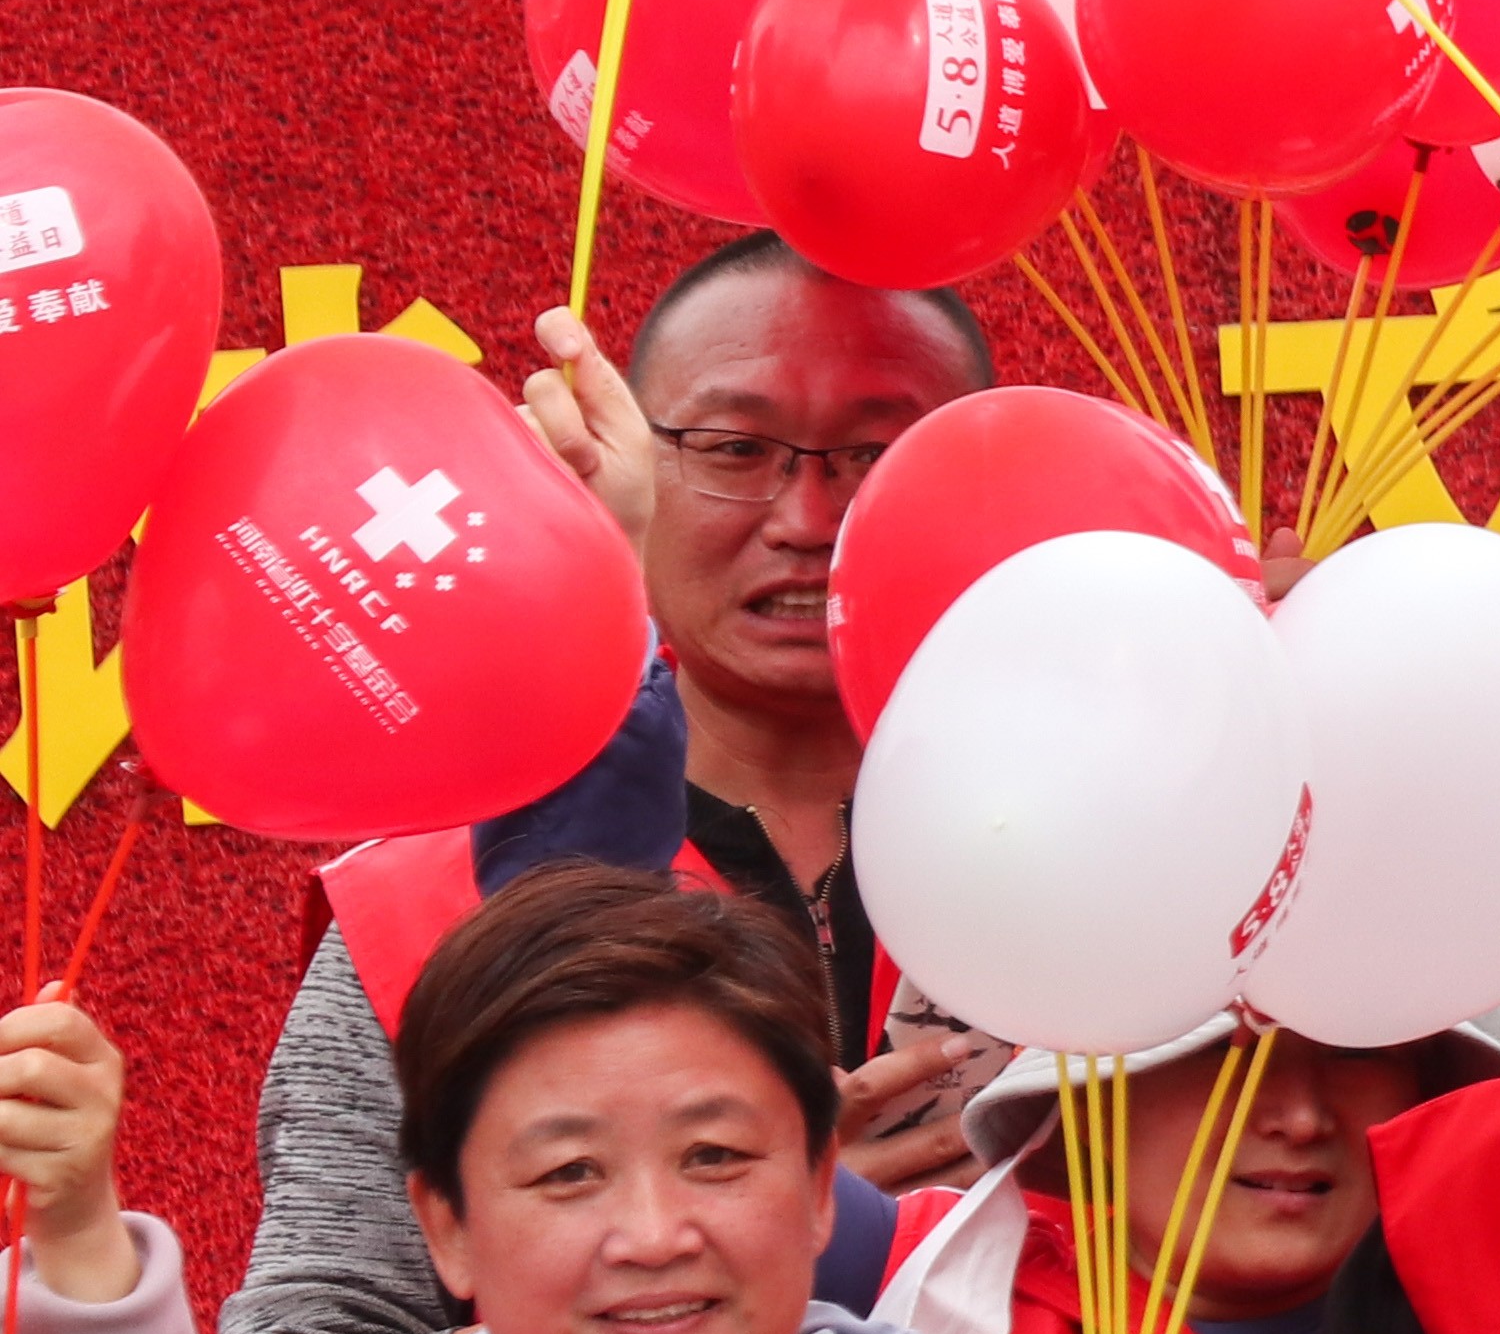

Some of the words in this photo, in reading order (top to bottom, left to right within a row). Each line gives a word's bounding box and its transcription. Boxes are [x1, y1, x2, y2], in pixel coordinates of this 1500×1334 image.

[992, 104, 1023, 170] 人道
[27, 278, 111, 324] 奉献
[227, 515, 420, 724] 河南省红十字基金会
[299, 525, 409, 634] HNRCF
